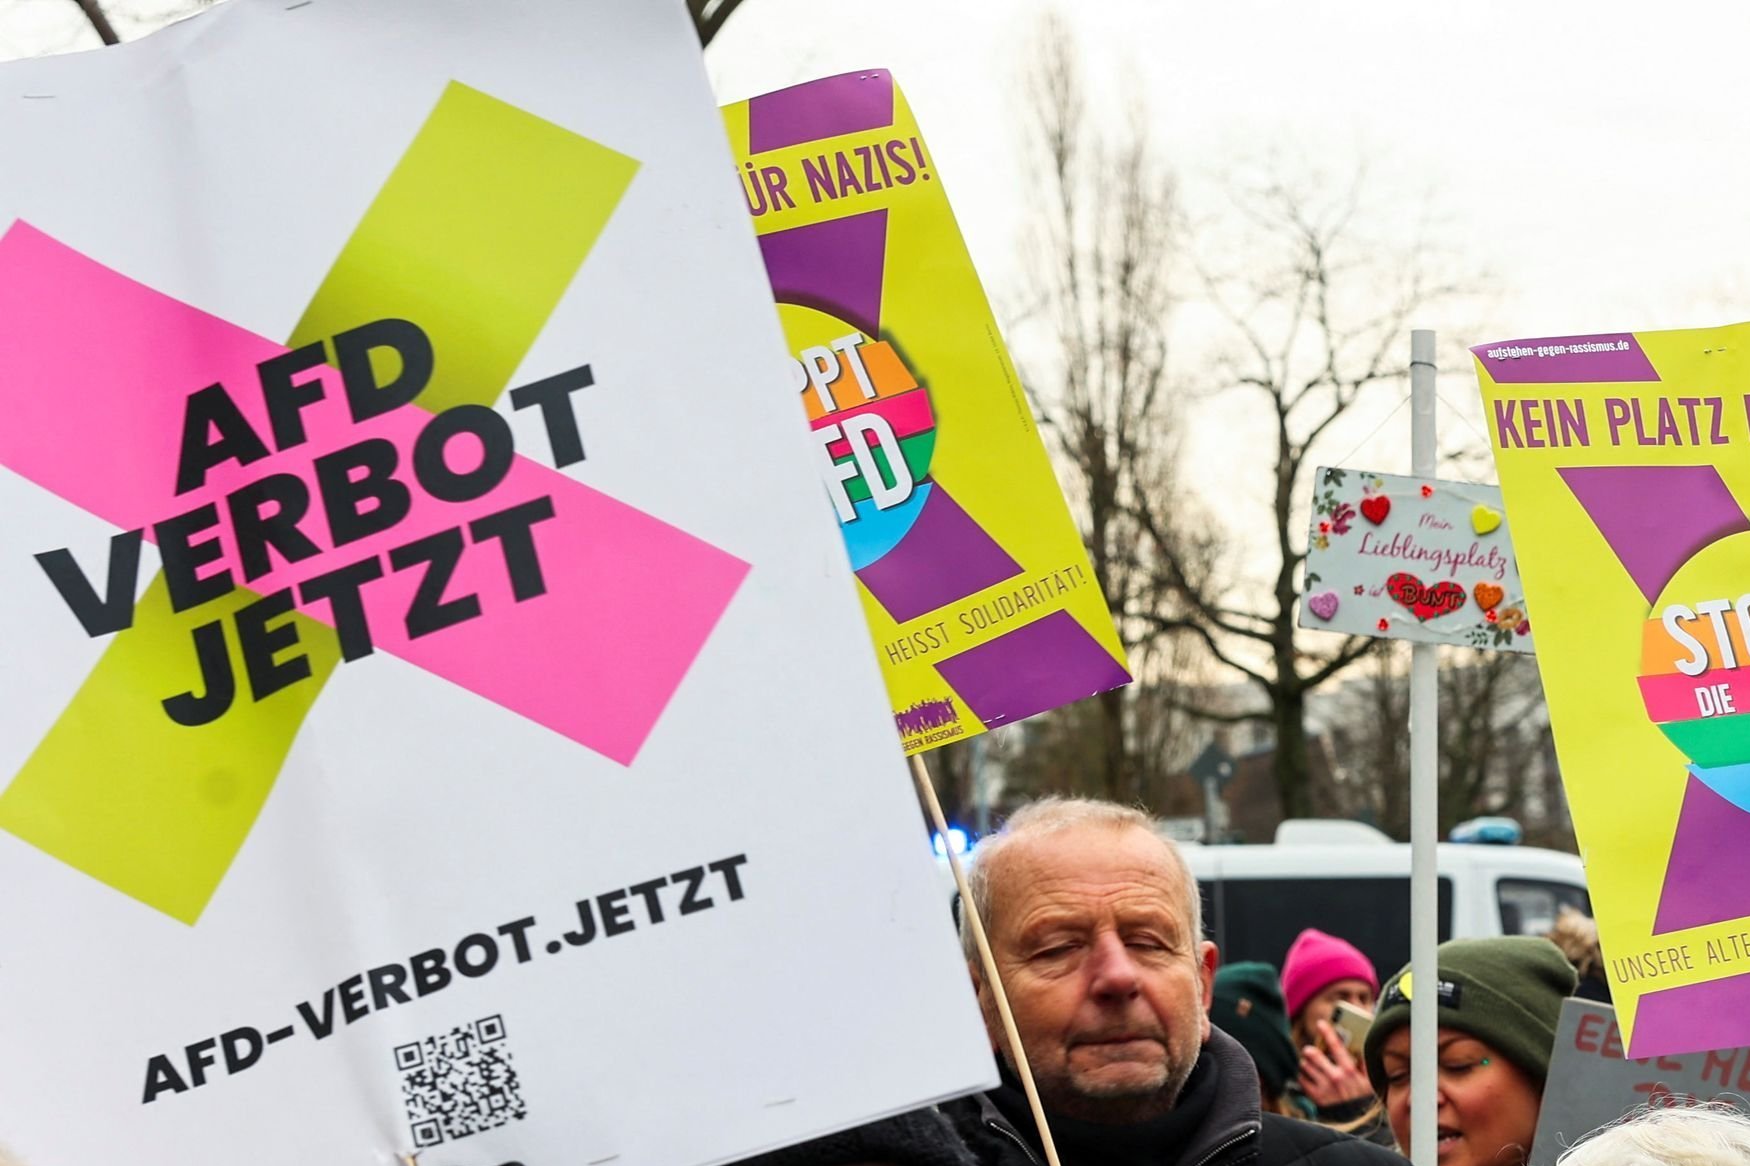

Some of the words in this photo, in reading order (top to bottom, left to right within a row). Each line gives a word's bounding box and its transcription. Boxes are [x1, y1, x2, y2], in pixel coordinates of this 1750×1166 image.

[801, 137, 930, 203] NAZIS!
[1487, 340, 1630, 359] aufstehen-gegen-rassismus.de
[174, 318, 434, 498] AFD
[1494, 398, 1590, 449] KEIN
[1605, 397, 1730, 446] PLATZ
[34, 364, 596, 638] VERBOT
[1418, 512, 1454, 531] Mein
[1358, 532, 1508, 580] Lieblingsplatz
[161, 495, 556, 728] JETZT
[884, 622, 950, 666] HEISST
[959, 564, 1087, 635] SOLIDARITÄT!
[1401, 583, 1463, 609] BUNT
[1694, 683, 1737, 718] DIE
[924, 725, 964, 745] RASSISMUS
[141, 854, 749, 1104] AFD-VERBOT.JETZT
[1612, 945, 1694, 985] UNSERE
